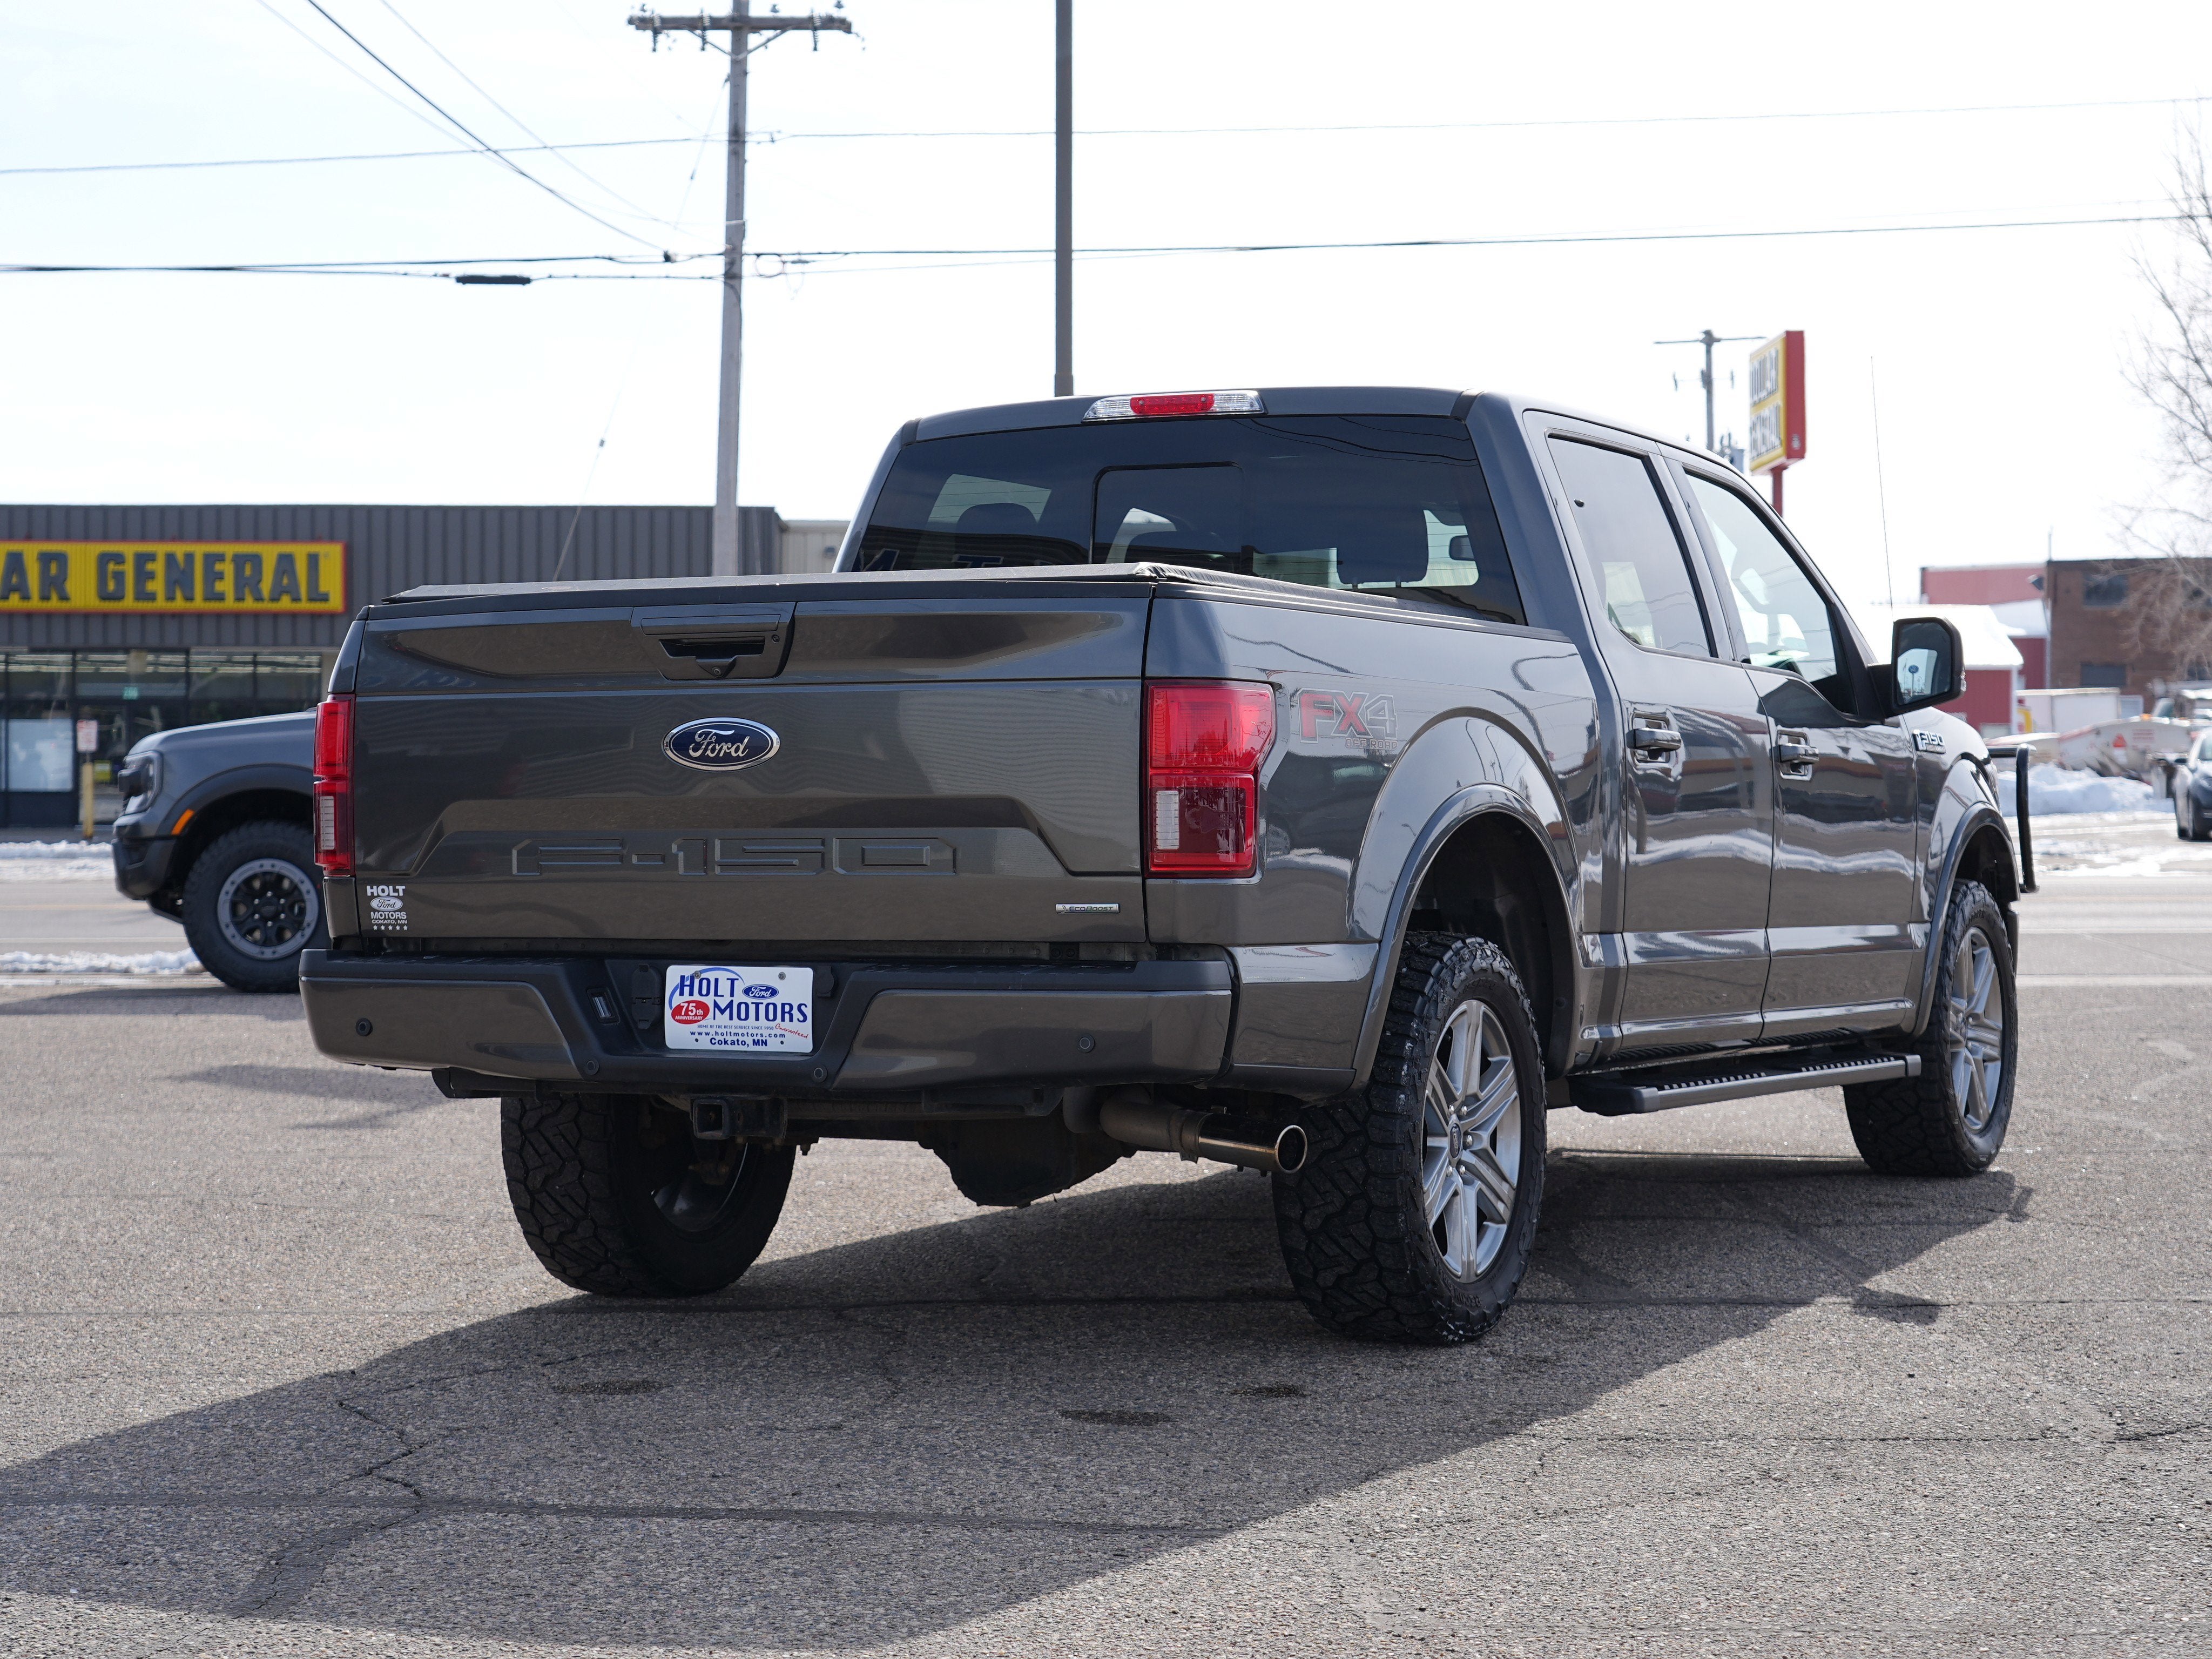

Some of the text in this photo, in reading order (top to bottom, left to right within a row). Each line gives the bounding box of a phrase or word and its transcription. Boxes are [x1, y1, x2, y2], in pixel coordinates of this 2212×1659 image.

[97, 551, 330, 602] GENERAL
[1297, 687, 1398, 744] FX4
[689, 729, 749, 758] Ford
[1345, 738, 1398, 750] OFF ROAD
[512, 838, 957, 876] F-150
[367, 885, 406, 896] HOLT
[377, 899, 396, 908] Ford
[370, 911, 407, 920] MOTORS
[679, 975, 739, 997] HOLT
[748, 986, 772, 997] Ford
[680, 1003, 703, 1016] 75th
[713, 999, 808, 1023] MOTORS
[690, 1030, 785, 1038] www.holtmotors.com
[775, 1023, 809, 1038] Guaranteed
[710, 1037, 767, 1048] Cokato, MN
